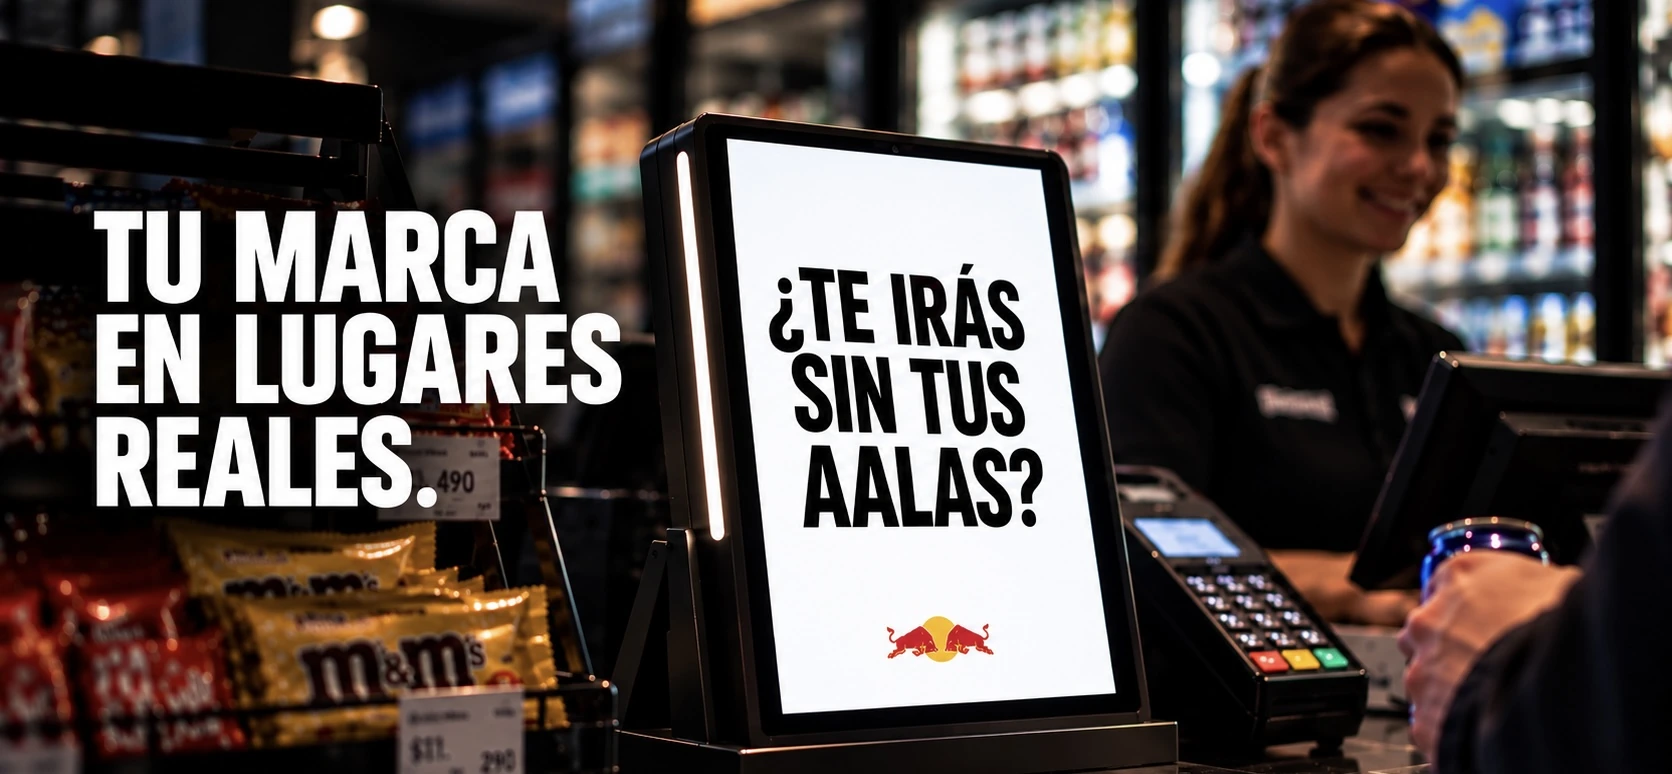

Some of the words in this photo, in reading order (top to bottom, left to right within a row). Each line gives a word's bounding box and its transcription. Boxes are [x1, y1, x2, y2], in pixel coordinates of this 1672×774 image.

[769, 266, 875, 353] ¿TE
[890, 263, 1025, 351] IRÁS
[791, 352, 897, 434] SIN
[909, 357, 1026, 437] TUS
[437, 469, 474, 493] 490
[803, 444, 1044, 528] AALAS?
